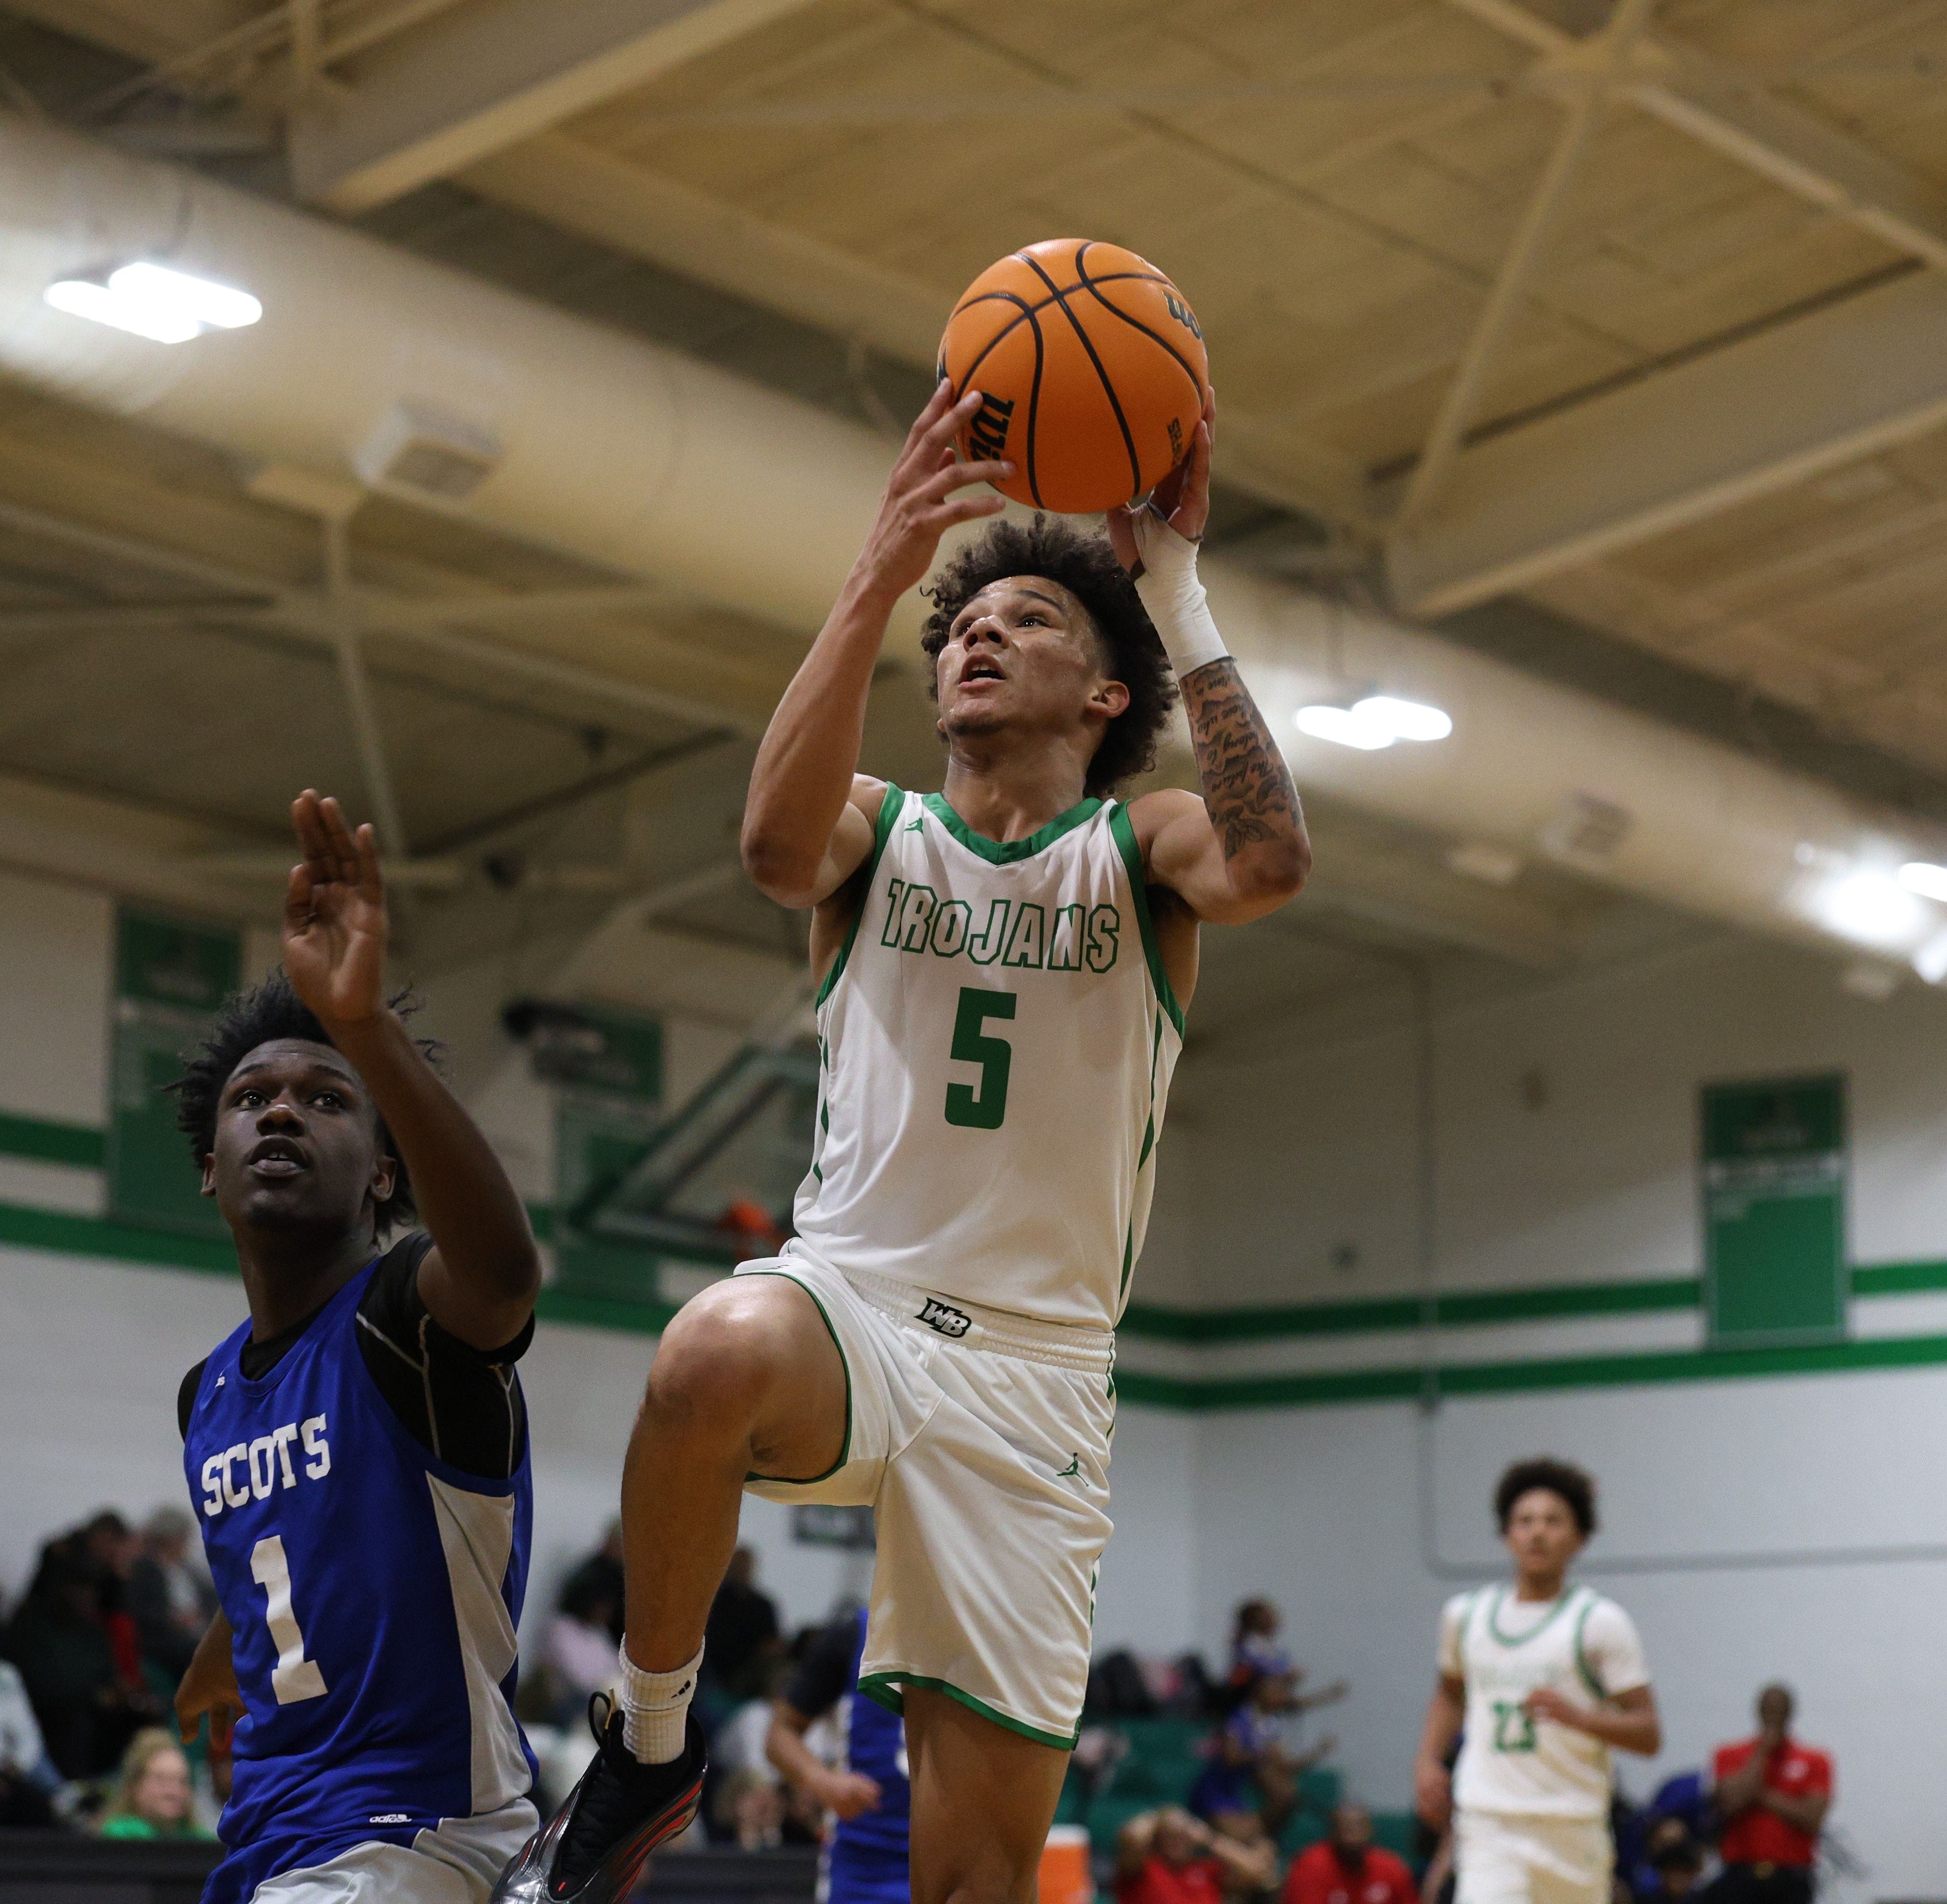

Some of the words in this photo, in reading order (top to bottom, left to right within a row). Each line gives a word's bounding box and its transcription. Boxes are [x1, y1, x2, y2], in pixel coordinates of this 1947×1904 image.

[880, 878, 1120, 973] TROJANS
[944, 987, 1017, 1130] 5
[914, 1297, 971, 1338] WB
[201, 1413, 331, 1517] SCOTS
[250, 1535, 328, 1705] 1
